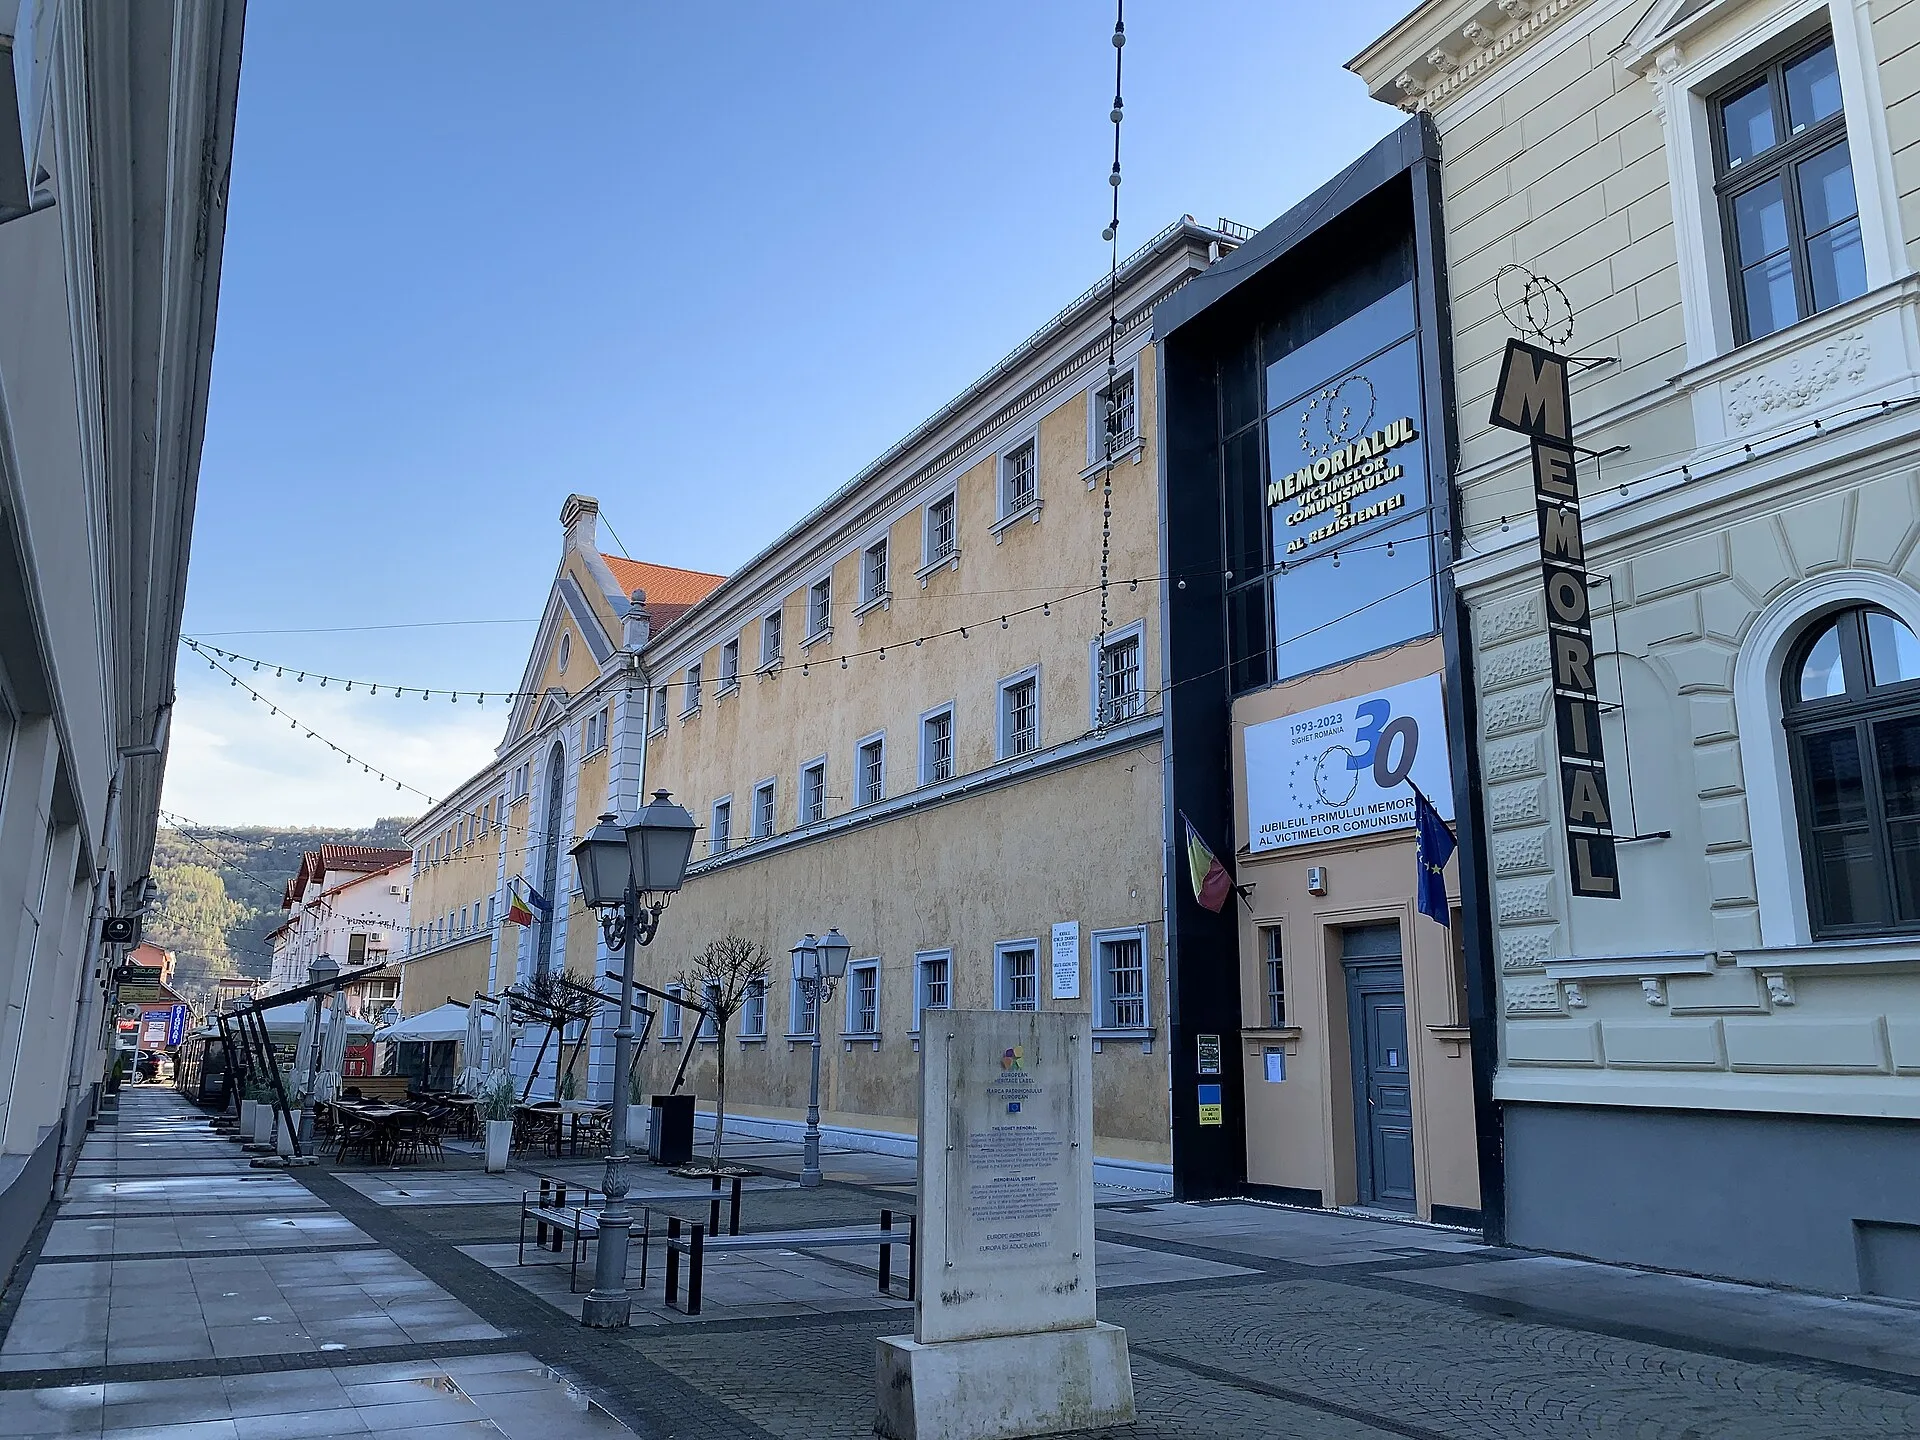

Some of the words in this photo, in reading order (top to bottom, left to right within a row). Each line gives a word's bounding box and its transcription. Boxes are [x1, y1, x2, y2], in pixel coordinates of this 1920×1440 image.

[1267, 416, 1419, 508] MEMORIALUL
[1296, 456, 1388, 507] VICTIMELOR
[1285, 464, 1404, 527] COMUNISMULUI
[1286, 536, 1308, 554] AL
[1498, 347, 1615, 894] MEMORIAL
[1290, 713, 1344, 736] 1993-2023
[1291, 733, 1314, 746] SIGHET
[1345, 697, 1420, 789] 30
[1258, 817, 1309, 834] JUBILEUL
[1311, 806, 1365, 825] PRIMULUI
[1367, 794, 1436, 815] MEMORL
[1258, 837, 1274, 847] AL
[1275, 824, 1341, 844] VICTIMELOR
[1343, 806, 1439, 832] COMUNISMU
[979, 1244, 1002, 1252] EUROPA
[1009, 1242, 1028, 1250] ADUCE
[986, 1233, 1009, 1241] EUROPE
